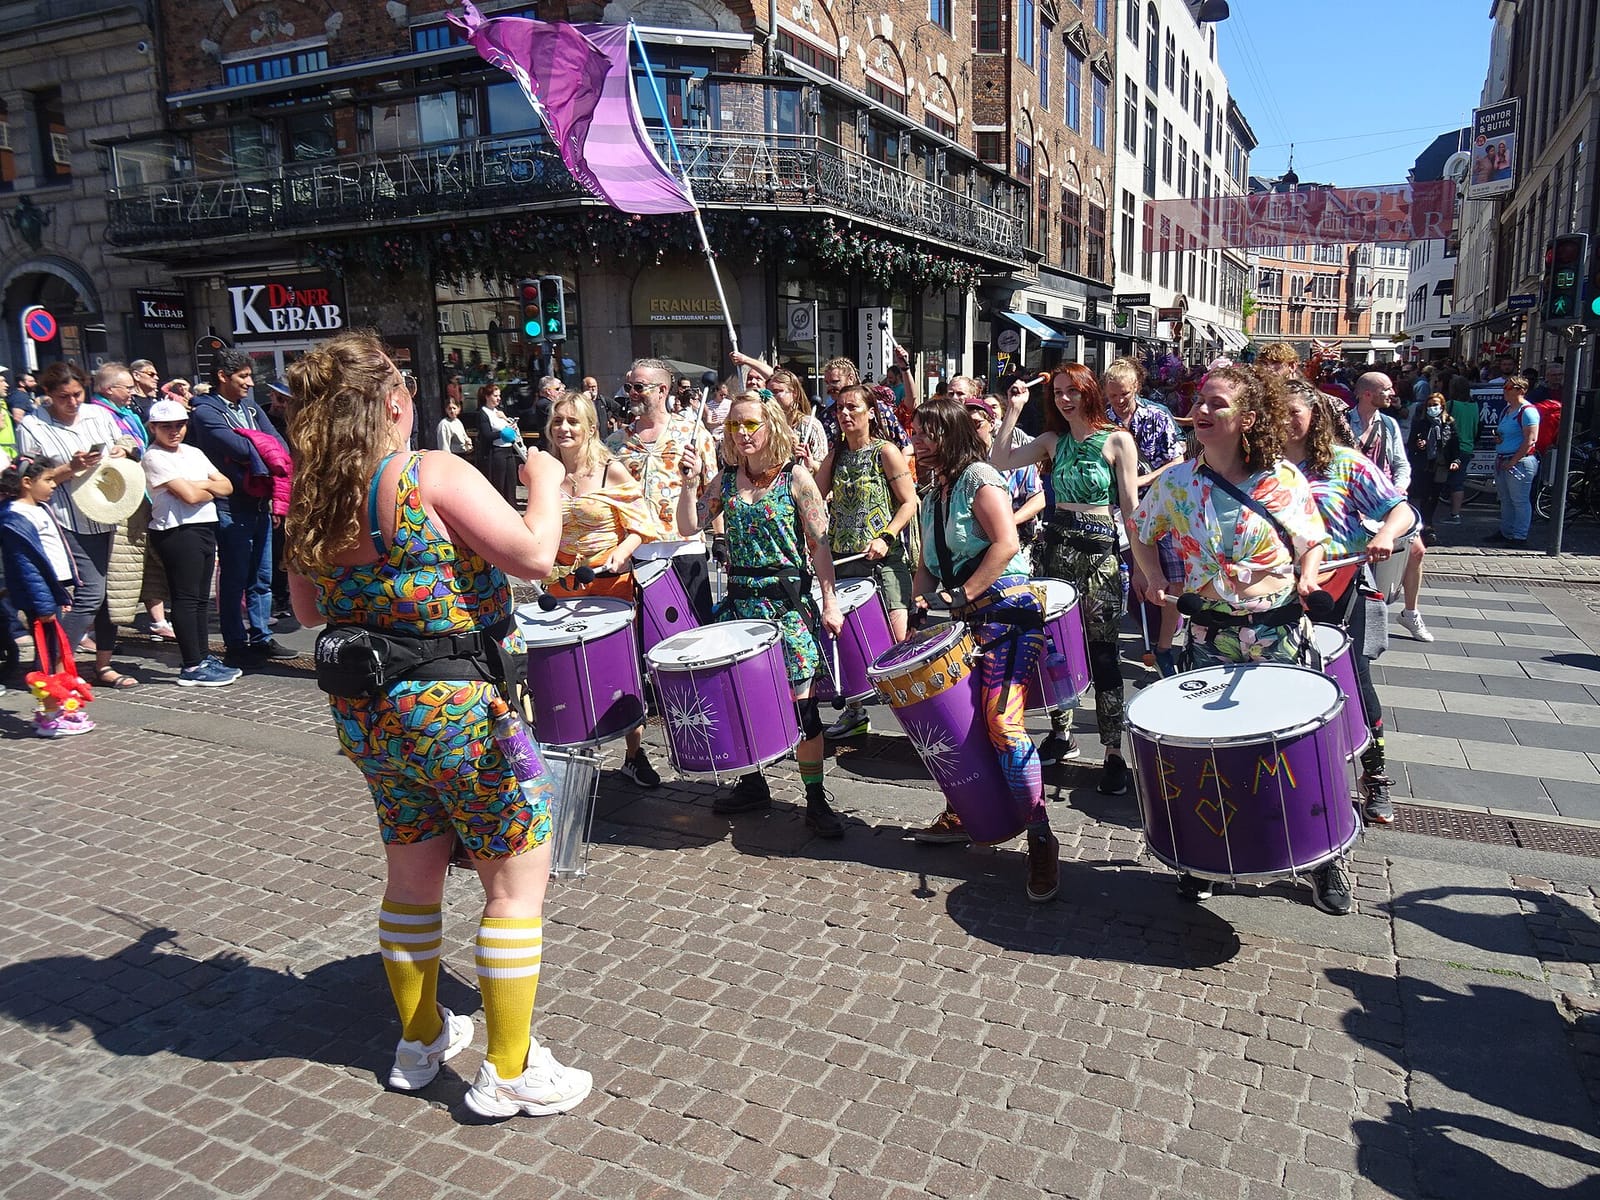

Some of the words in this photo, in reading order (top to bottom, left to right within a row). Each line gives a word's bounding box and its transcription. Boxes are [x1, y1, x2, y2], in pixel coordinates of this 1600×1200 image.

[1480, 109, 1511, 124] KONTOR
[1480, 125, 1486, 133] &
[1487, 119, 1511, 131] BUTIK
[313, 138, 535, 209] FRANKIES
[667, 137, 780, 185] IZZA
[847, 153, 942, 224] FRANKIES
[1190, 190, 1312, 227] NEVER
[1322, 186, 1414, 215] NOT
[1191, 211, 1447, 247] SPECTACULAR
[142, 301, 184, 318] KEBAB
[228, 285, 343, 334] KEBAB
[649, 298, 722, 312] FRANKIES
[794, 313, 807, 323] 40
[1182, 683, 1231, 700] TIMBRA
